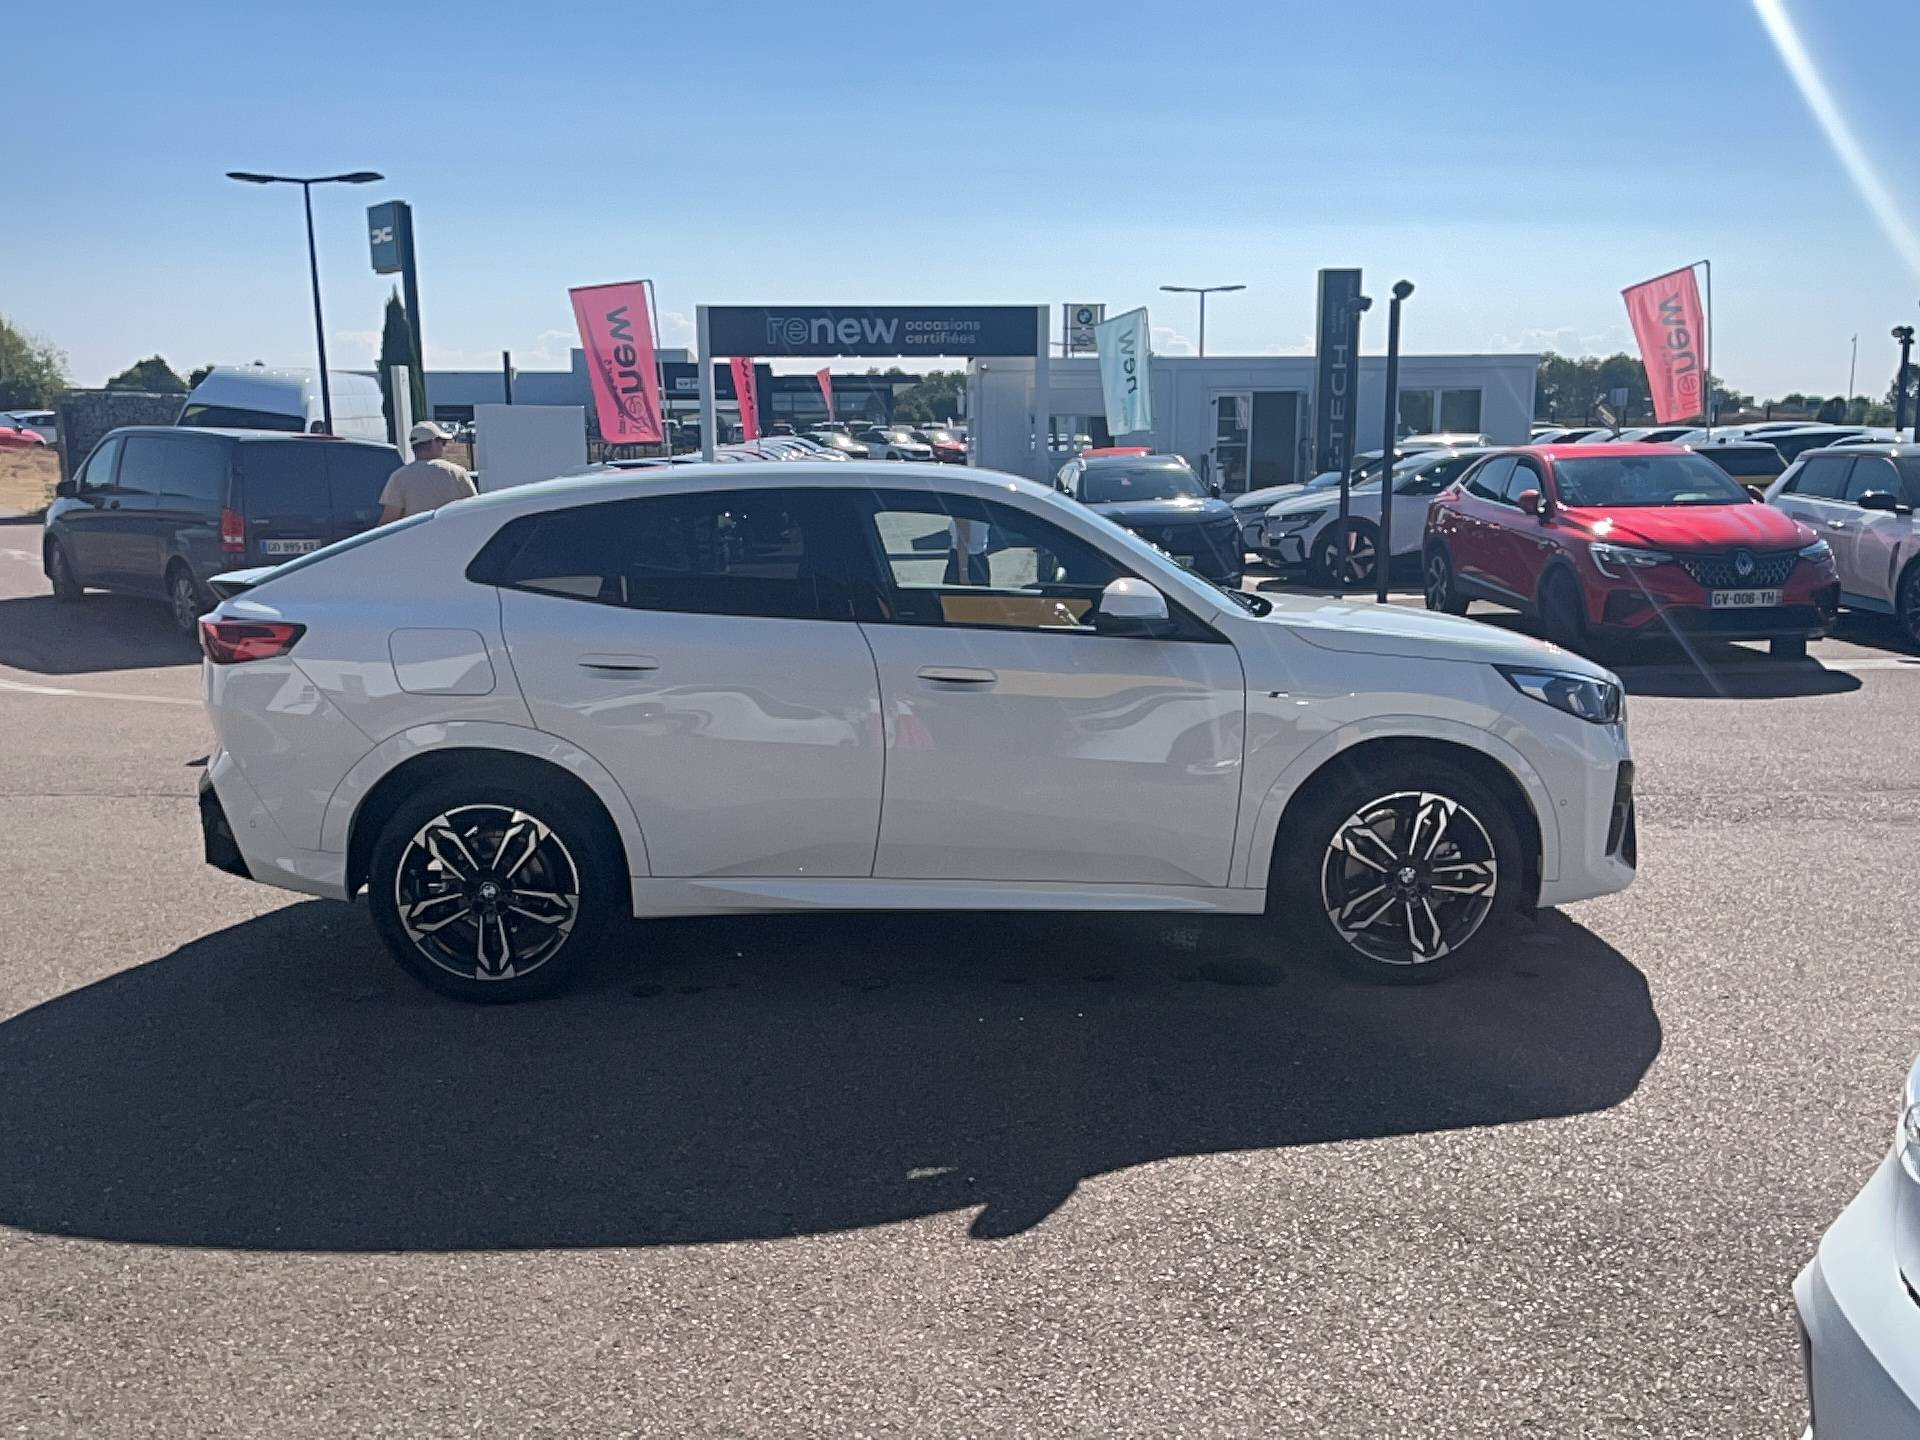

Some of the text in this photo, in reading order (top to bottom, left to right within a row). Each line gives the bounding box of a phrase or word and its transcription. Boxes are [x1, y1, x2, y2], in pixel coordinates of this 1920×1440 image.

[766, 317, 899, 345] renew
[905, 320, 981, 331] occasions
[905, 332, 977, 344] certifiées
